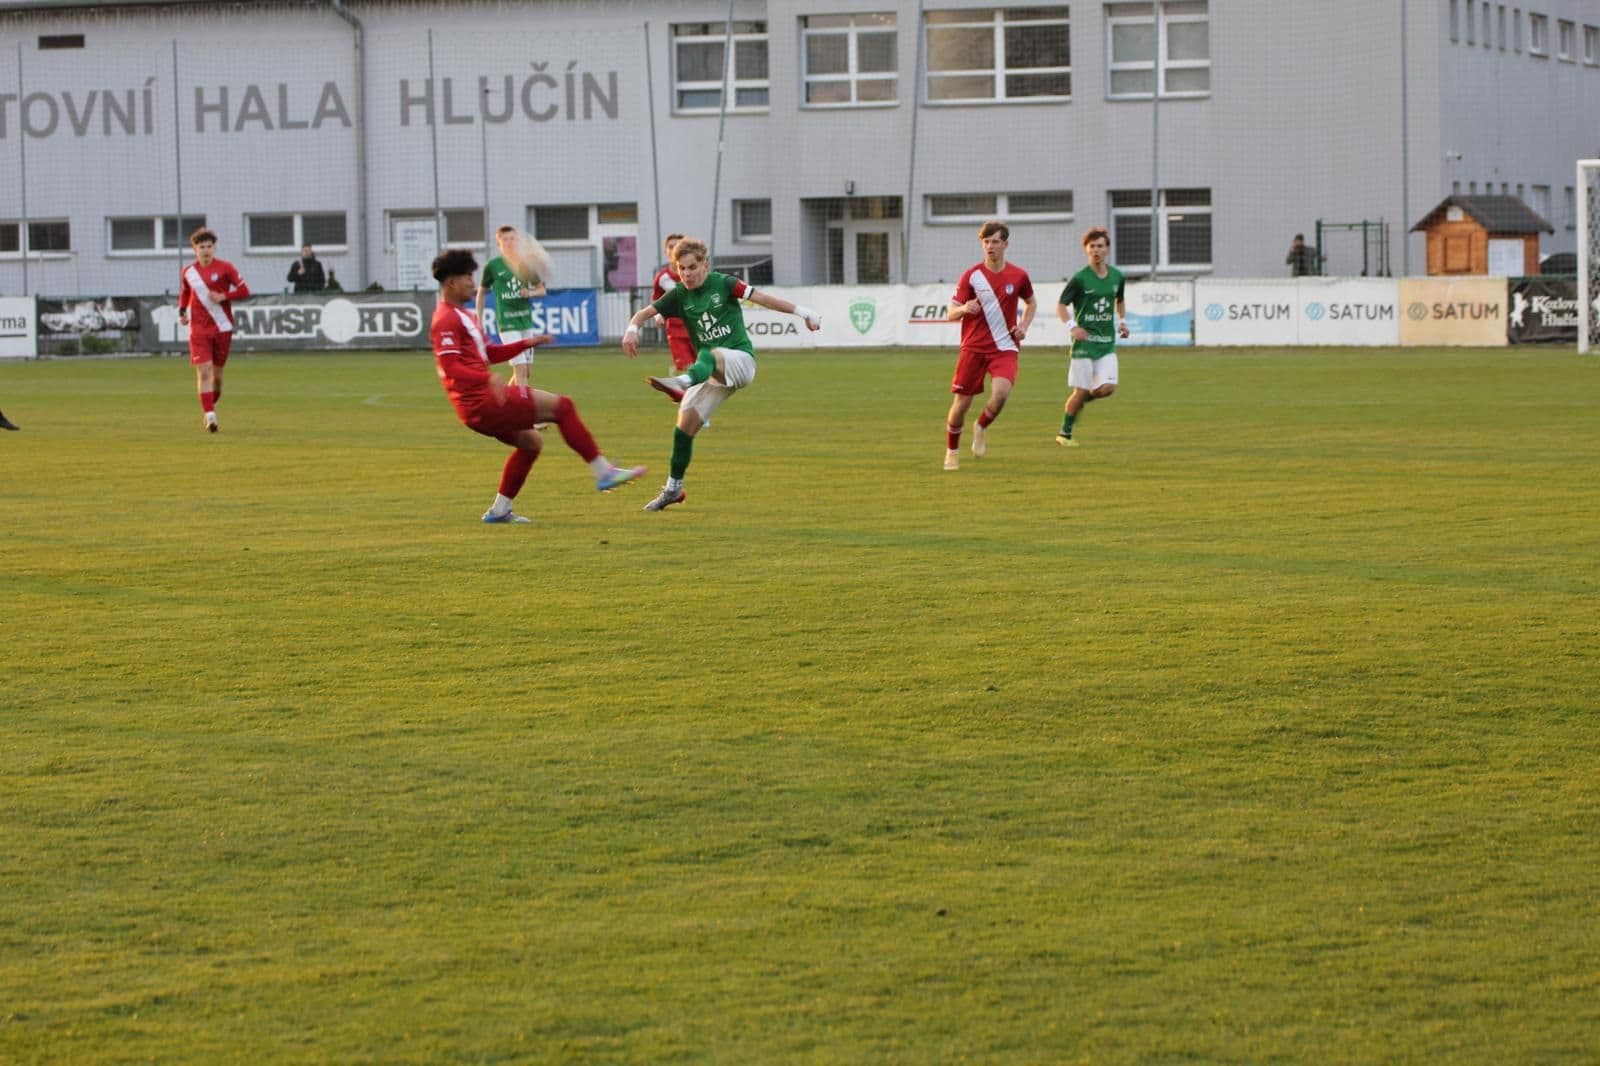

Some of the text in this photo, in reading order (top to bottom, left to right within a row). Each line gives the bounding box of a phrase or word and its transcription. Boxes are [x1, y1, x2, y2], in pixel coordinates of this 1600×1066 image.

[194, 80, 352, 133] HALA
[400, 60, 618, 126] HLUČÍN
[1228, 303, 1291, 320] SATUM
[1329, 303, 1394, 320] SATUM
[1432, 303, 1499, 320] SATUM
